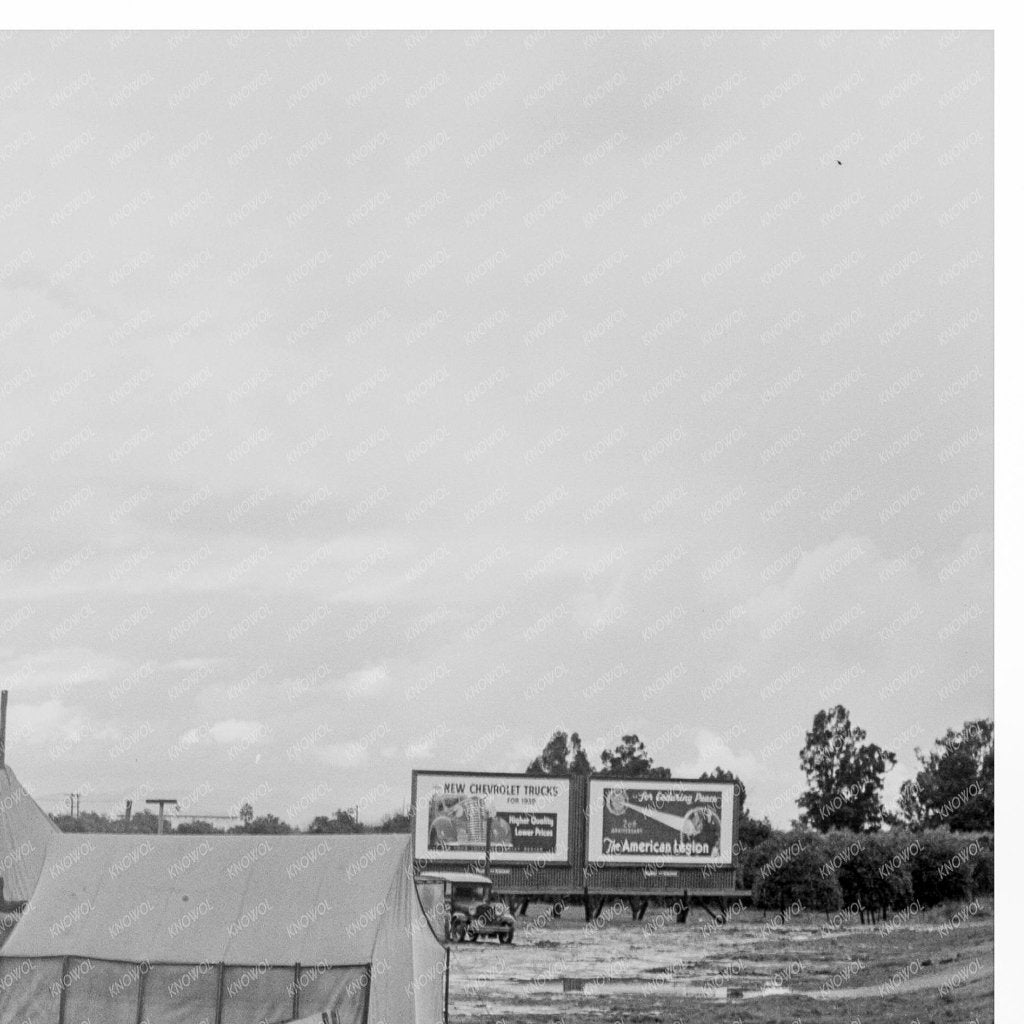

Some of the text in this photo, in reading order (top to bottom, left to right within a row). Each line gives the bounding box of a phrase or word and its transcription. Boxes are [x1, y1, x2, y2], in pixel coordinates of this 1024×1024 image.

[444, 782, 465, 794] NEW
[469, 783, 520, 796] CHEVROLET
[524, 785, 558, 797] TRUCKS
[508, 815, 554, 828] Higher Quality
[514, 827, 553, 837] Lower Prices
[603, 837, 709, 856] The American Legion
